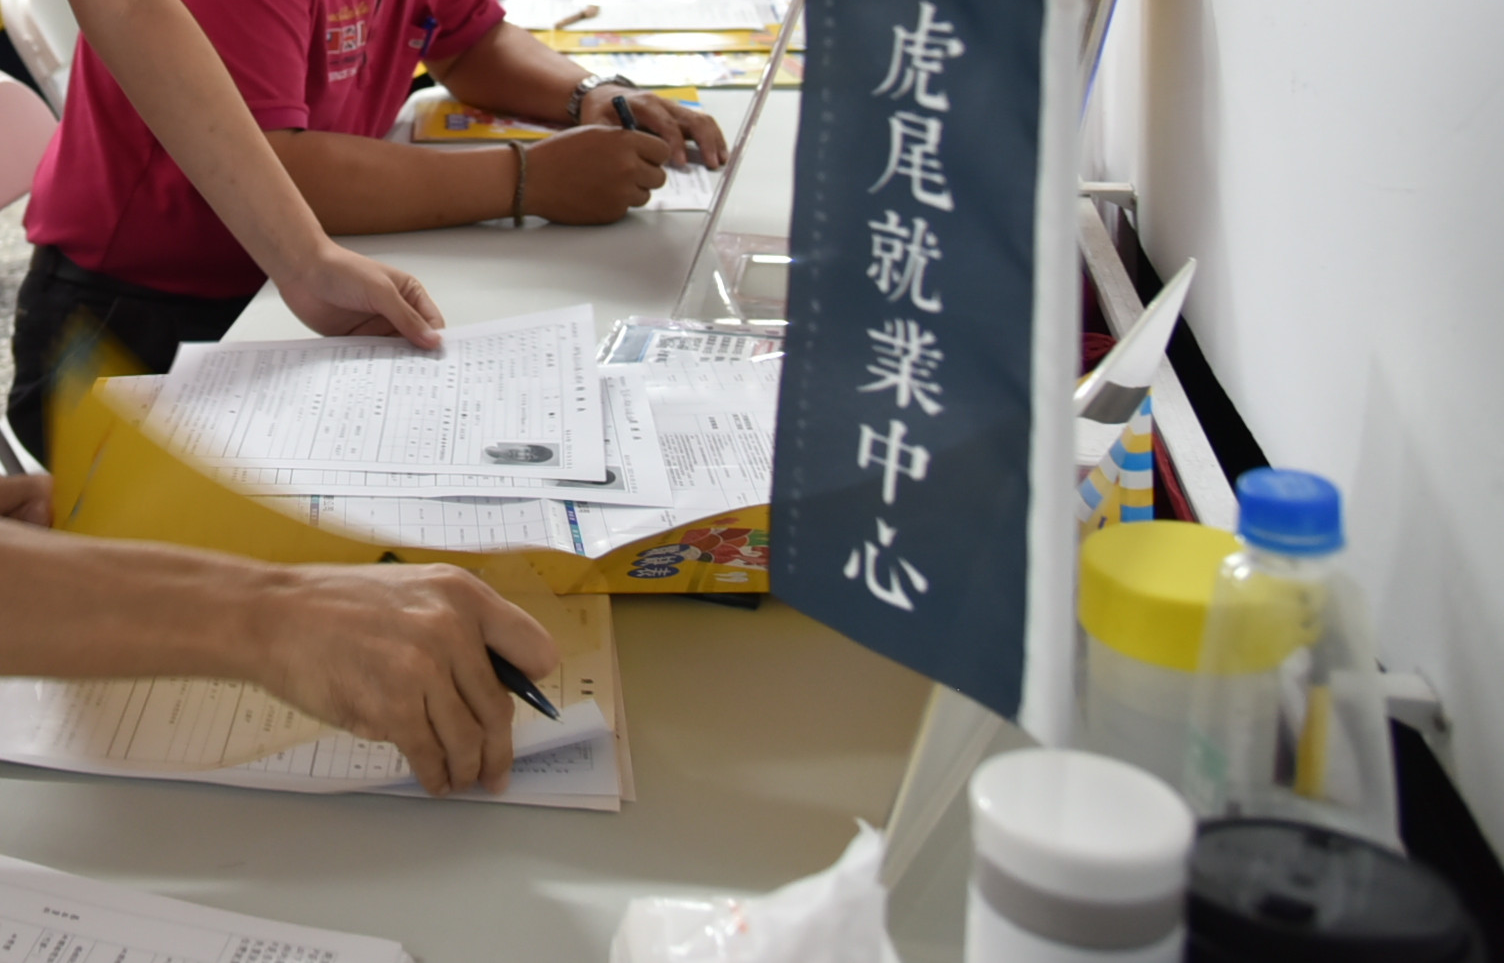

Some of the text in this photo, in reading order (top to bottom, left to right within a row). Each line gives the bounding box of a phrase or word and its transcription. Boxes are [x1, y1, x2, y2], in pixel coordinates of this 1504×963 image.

[843, 0, 965, 612] 虎尾就業中心
